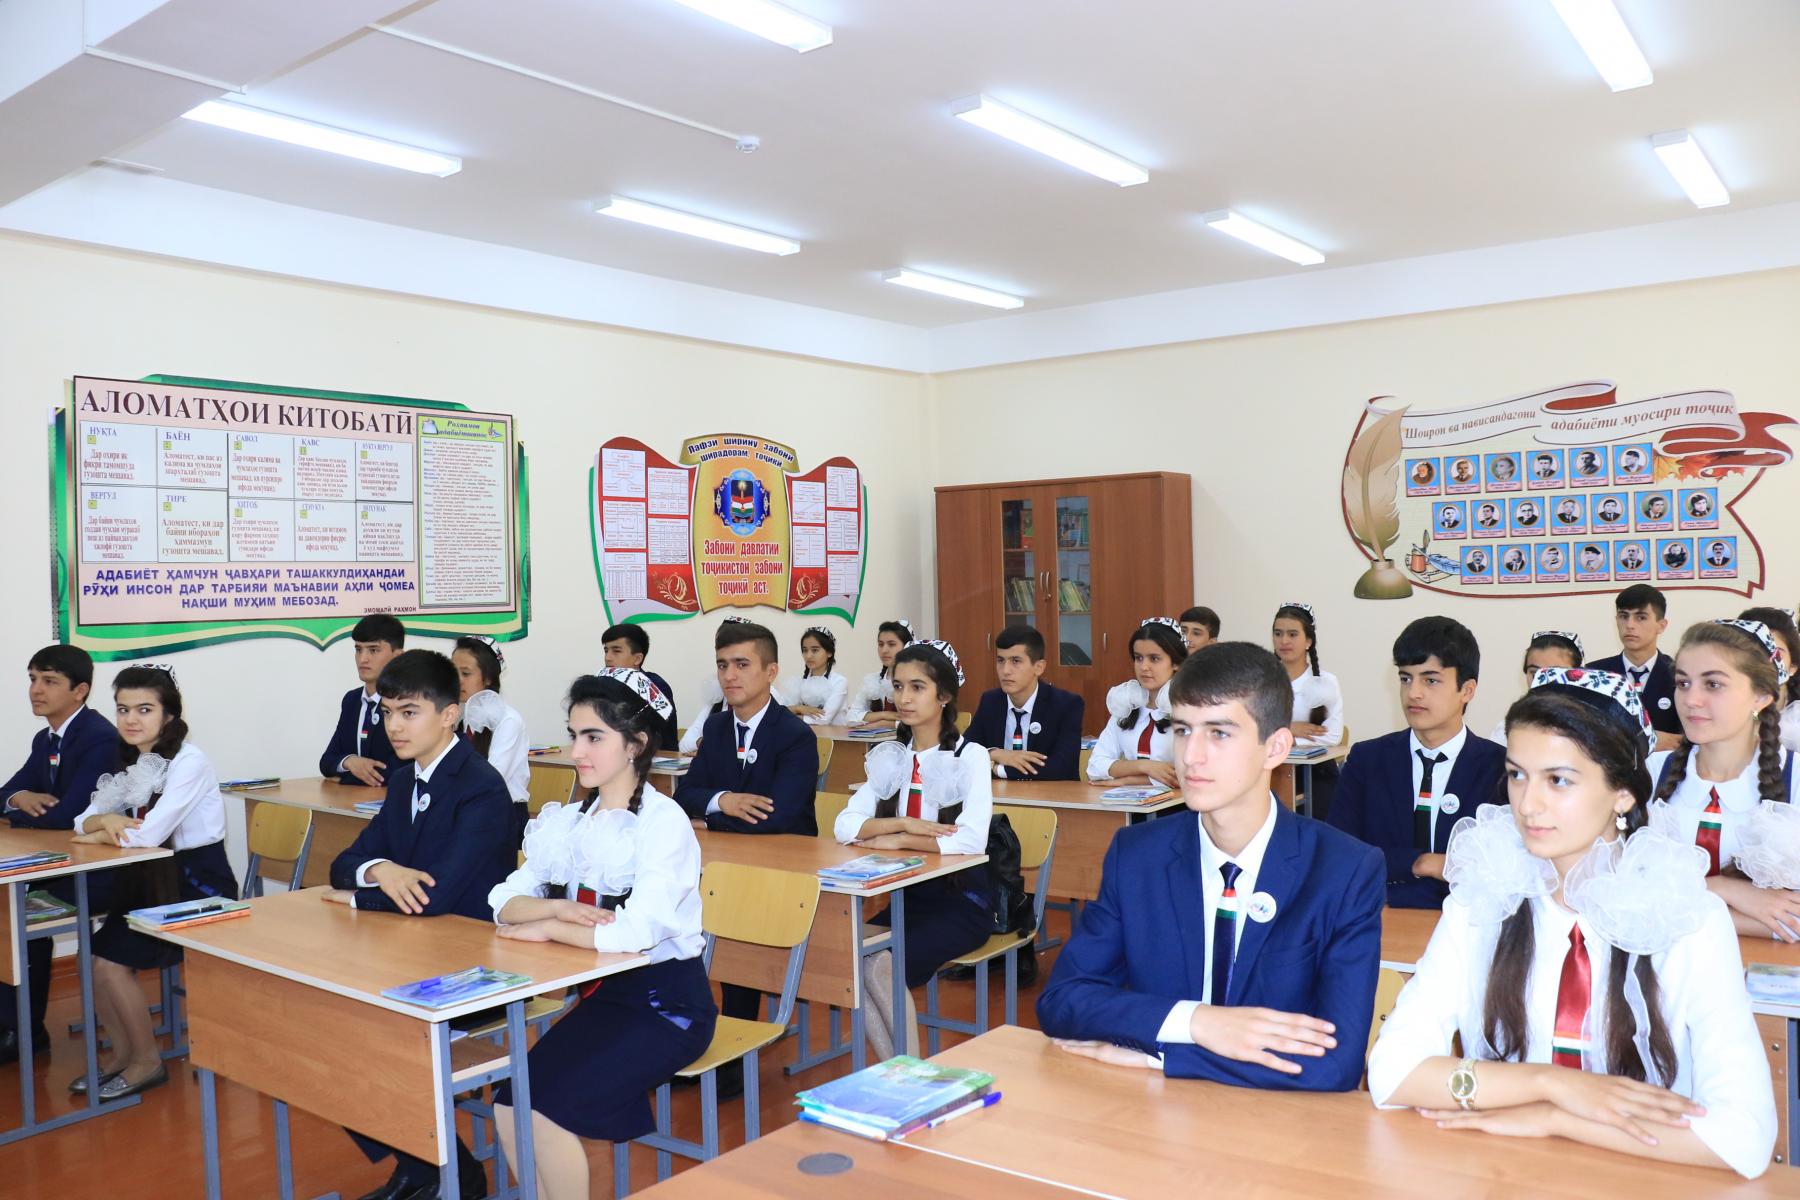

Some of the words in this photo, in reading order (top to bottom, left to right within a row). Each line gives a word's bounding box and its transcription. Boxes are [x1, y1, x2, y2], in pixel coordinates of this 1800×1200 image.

[80, 389, 269, 426] АЛОМАТҲОИ
[278, 404, 412, 434] КИТОБАТӢ
[1551, 417, 1617, 430] адабиёти
[1621, 407, 1681, 427] муосири
[1405, 427, 1446, 440] Шоирон
[1448, 423, 1459, 432] ва
[1462, 410, 1536, 430] нависандагони
[166, 430, 190, 440] БАЁН
[724, 438, 758, 448] ширину
[763, 443, 794, 461] забони
[704, 540, 735, 554] Забони
[755, 560, 783, 574] забони
[96, 569, 159, 581] АДАБИЁТ
[166, 569, 218, 581] ҲАМЧУН
[225, 568, 280, 581] ҶАВҲАРИ
[286, 568, 405, 580] ТАШАККУЛДИҲАНДАИ
[83, 583, 119, 597] РӮҲИ
[127, 584, 172, 595] ИНСОН
[179, 584, 205, 596] ДАР
[213, 583, 267, 594] ТАРБИЯИ
[274, 582, 339, 593] МАЪНАВИИ
[344, 582, 374, 593] АҲЛИ
[379, 581, 415, 593] ҶОМЕА
[754, 581, 769, 594] аст.
[182, 598, 227, 610] НАҚШИ
[234, 597, 276, 609] МУҲИМ
[282, 596, 339, 608] МЕБОЗАД.
